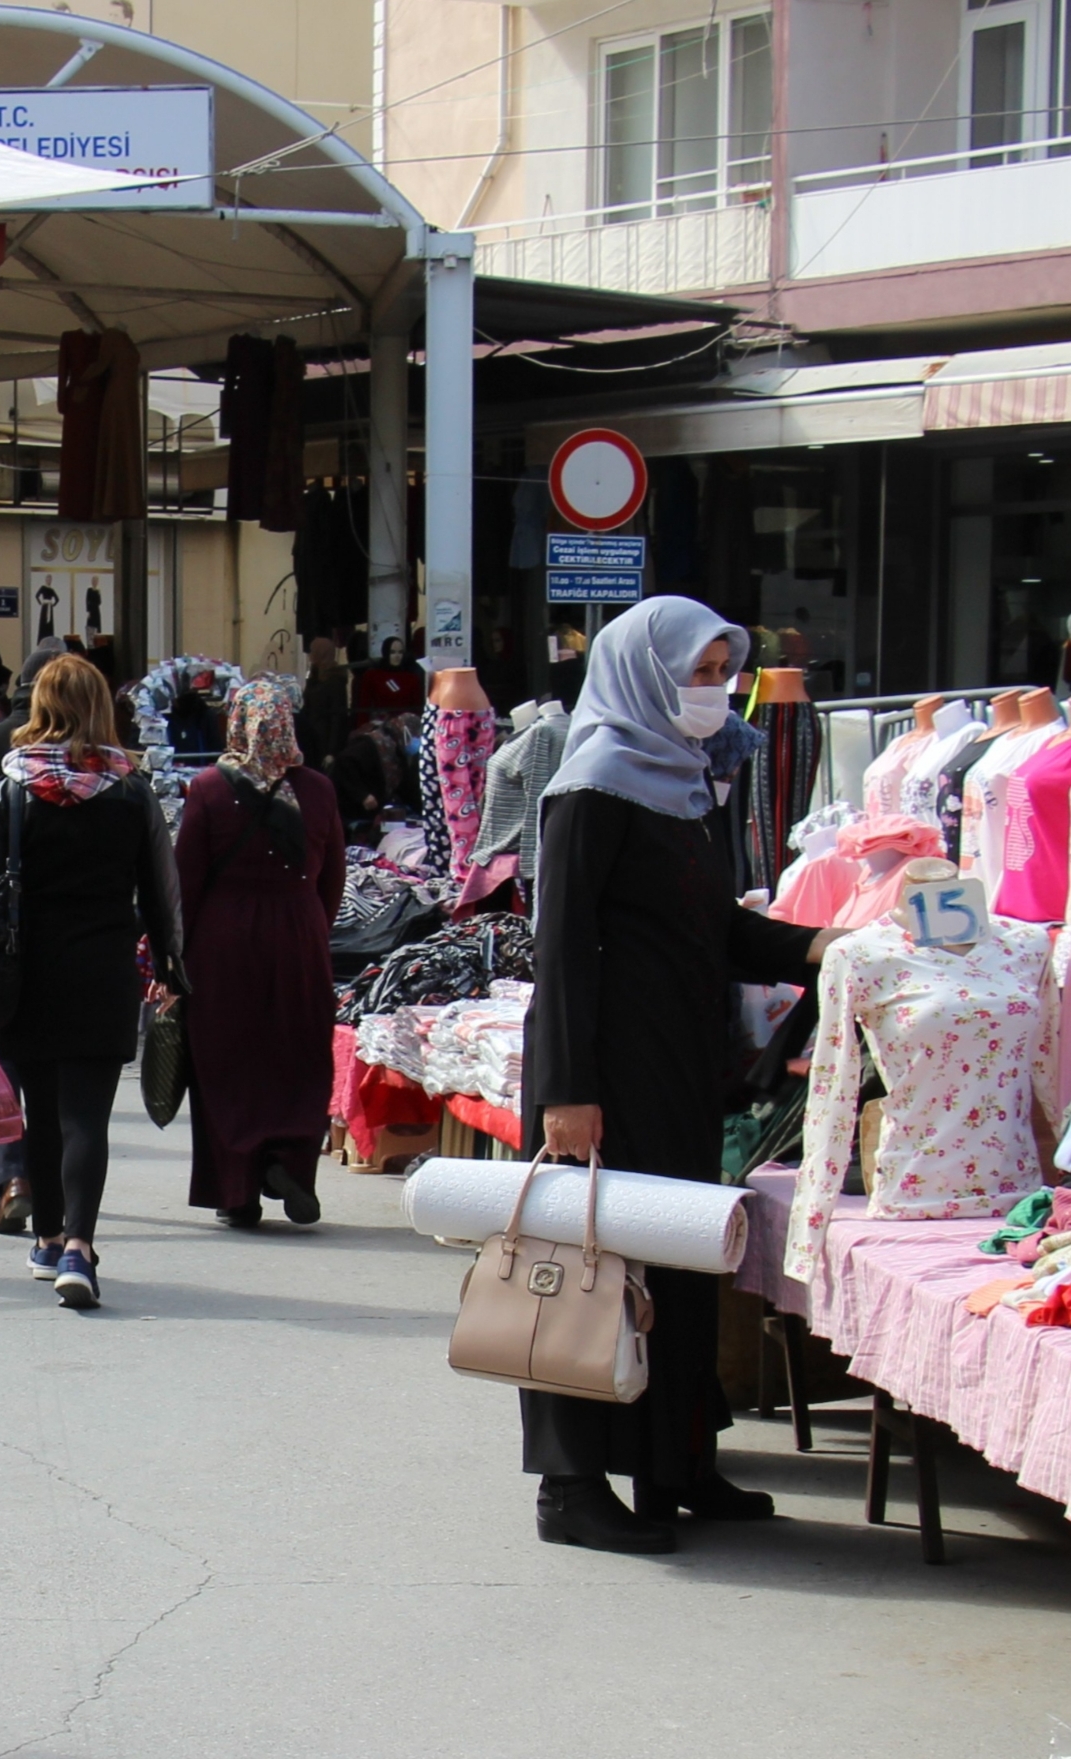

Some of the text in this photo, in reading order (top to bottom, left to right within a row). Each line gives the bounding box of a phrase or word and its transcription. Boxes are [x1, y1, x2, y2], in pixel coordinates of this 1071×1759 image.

[553, 545, 575, 554] Cezai
[550, 587, 638, 598] TRAFİĞE KAPALIDIR
[909, 887, 978, 947] 15
